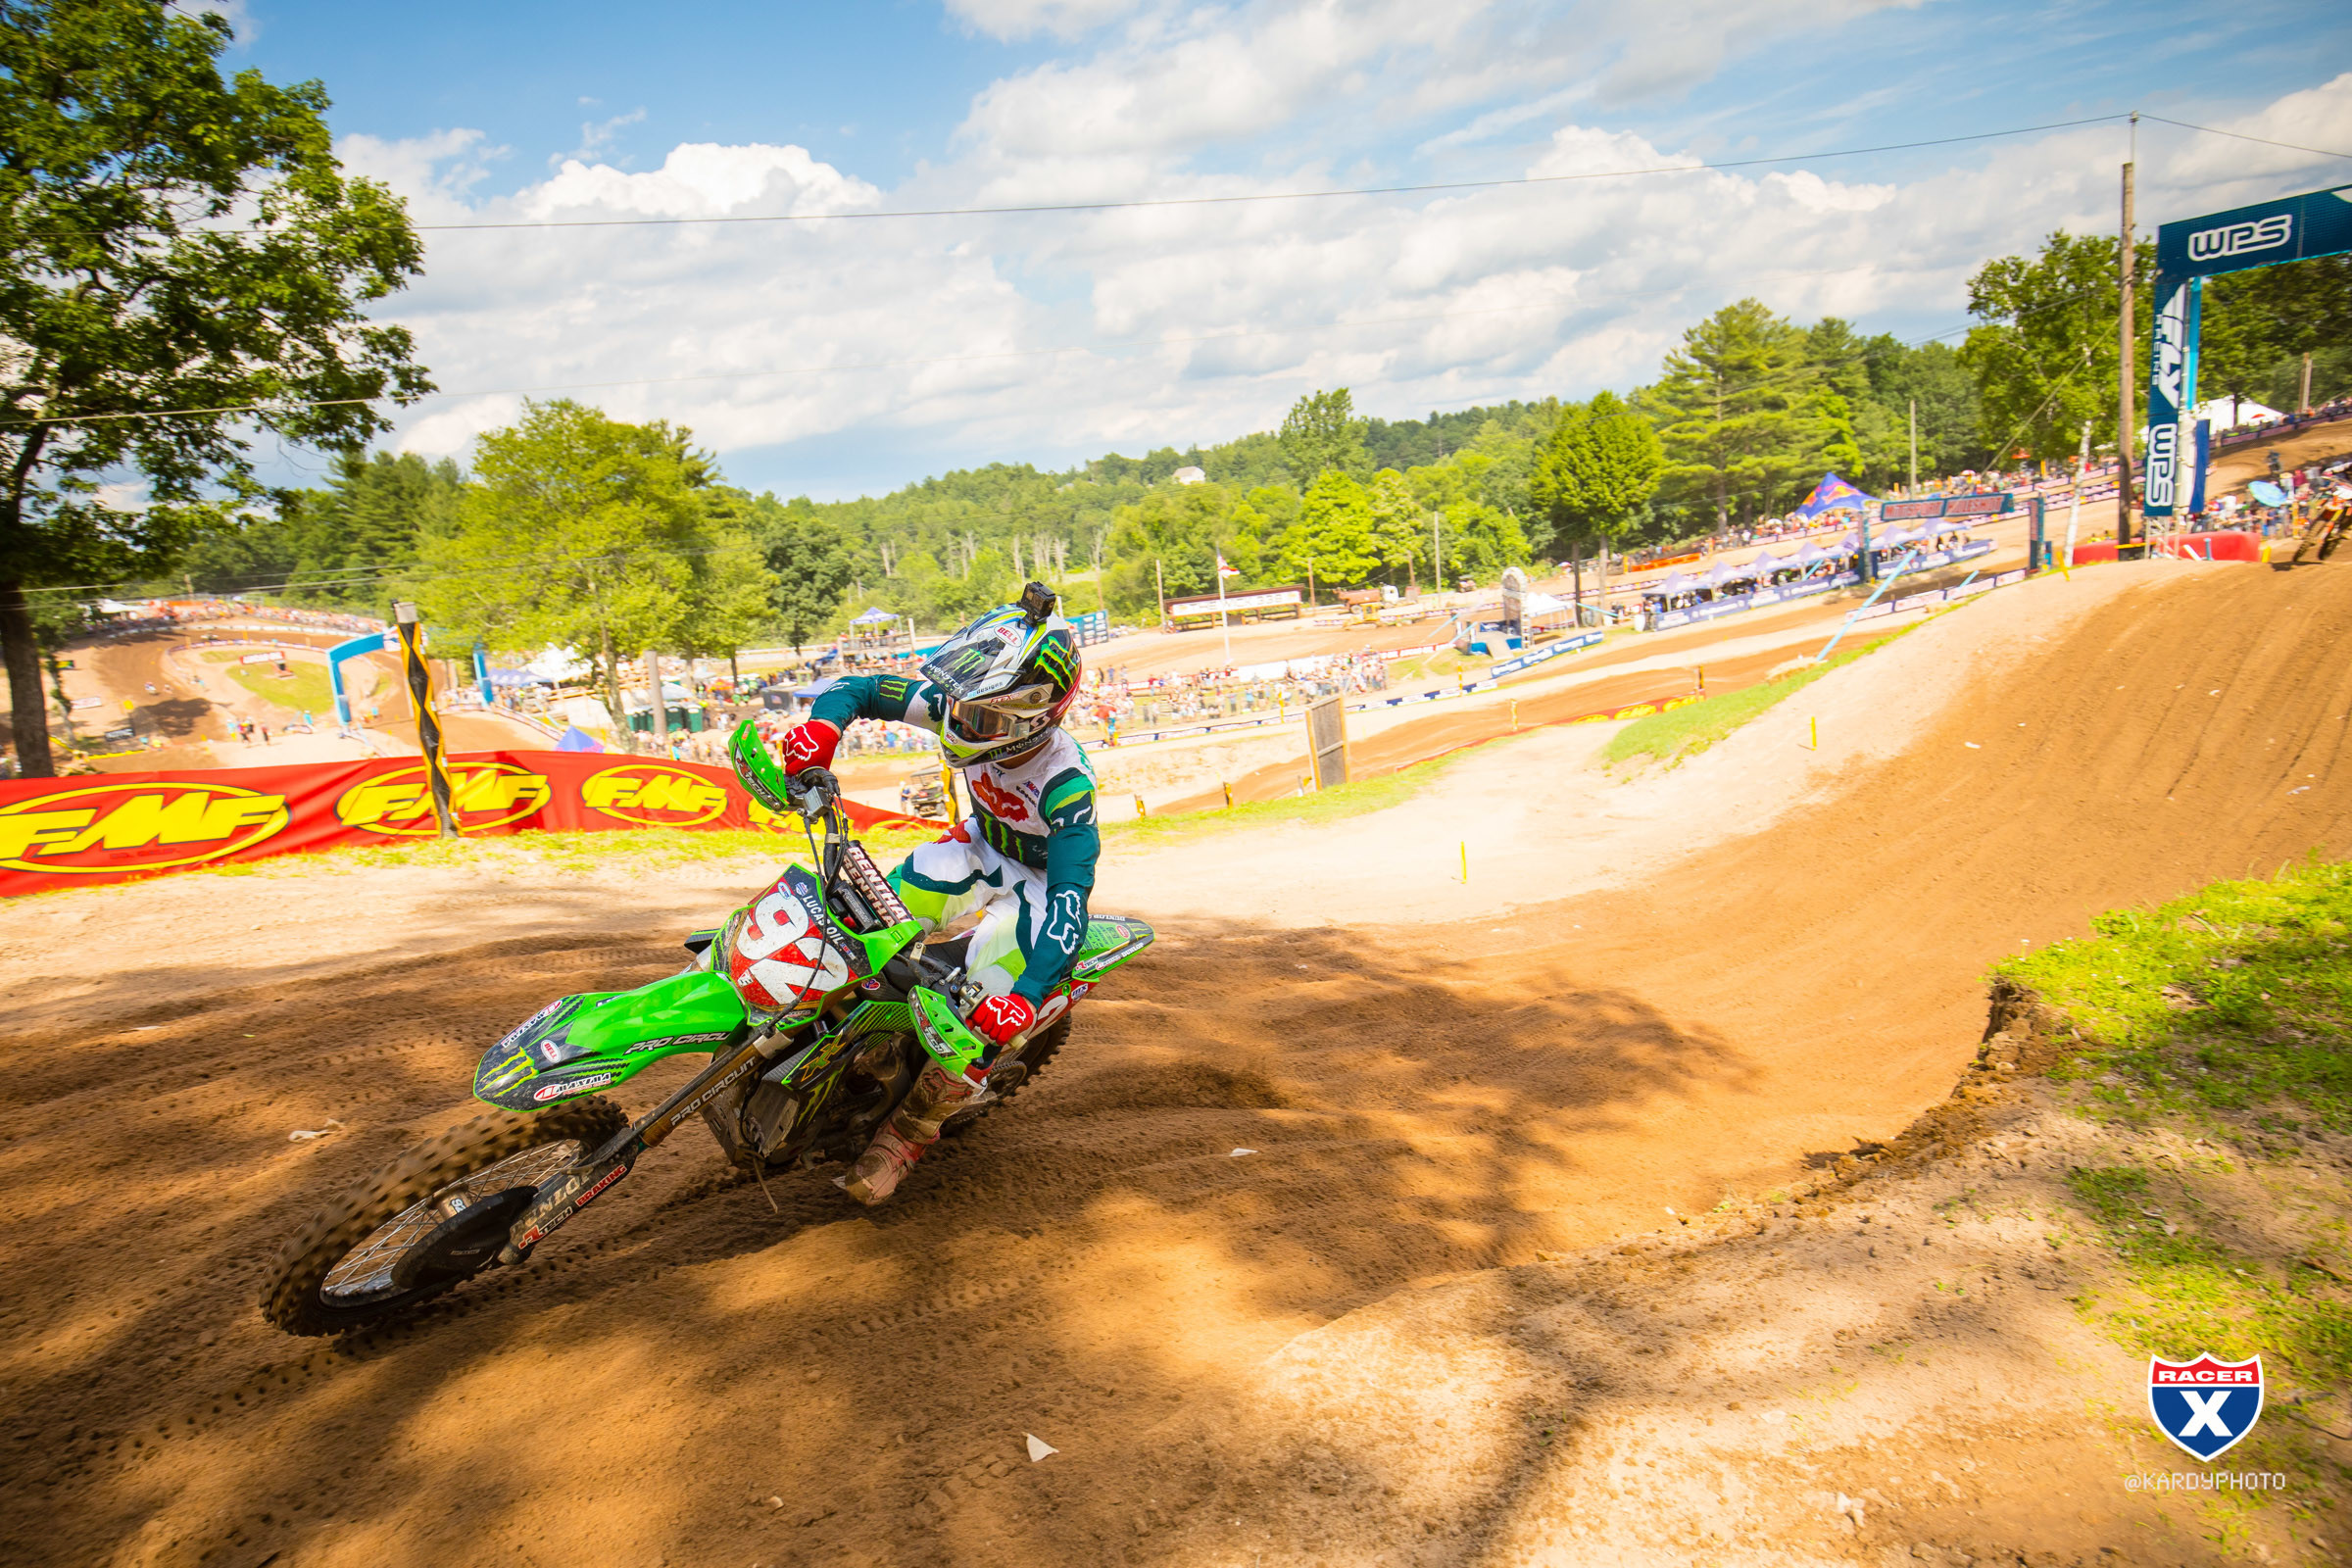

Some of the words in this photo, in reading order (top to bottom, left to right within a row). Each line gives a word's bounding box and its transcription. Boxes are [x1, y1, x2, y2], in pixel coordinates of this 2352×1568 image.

[2187, 214, 2293, 262] WPS
[2145, 422, 2178, 508] WPS
[998, 625, 1019, 645] BELL
[340, 768, 549, 827] FMF
[585, 774, 728, 813] FMF
[0, 790, 287, 860] FMF
[842, 854, 897, 928] RENTHA
[736, 891, 850, 1005] 92
[827, 926, 845, 946] OIL
[543, 1042, 558, 1060] BELL
[623, 1037, 674, 1055] PRO
[671, 1031, 732, 1046] CIRCU
[669, 1098, 702, 1126] PRO
[701, 1055, 757, 1103] CIRCUIT
[575, 1163, 627, 1207] BRAKING
